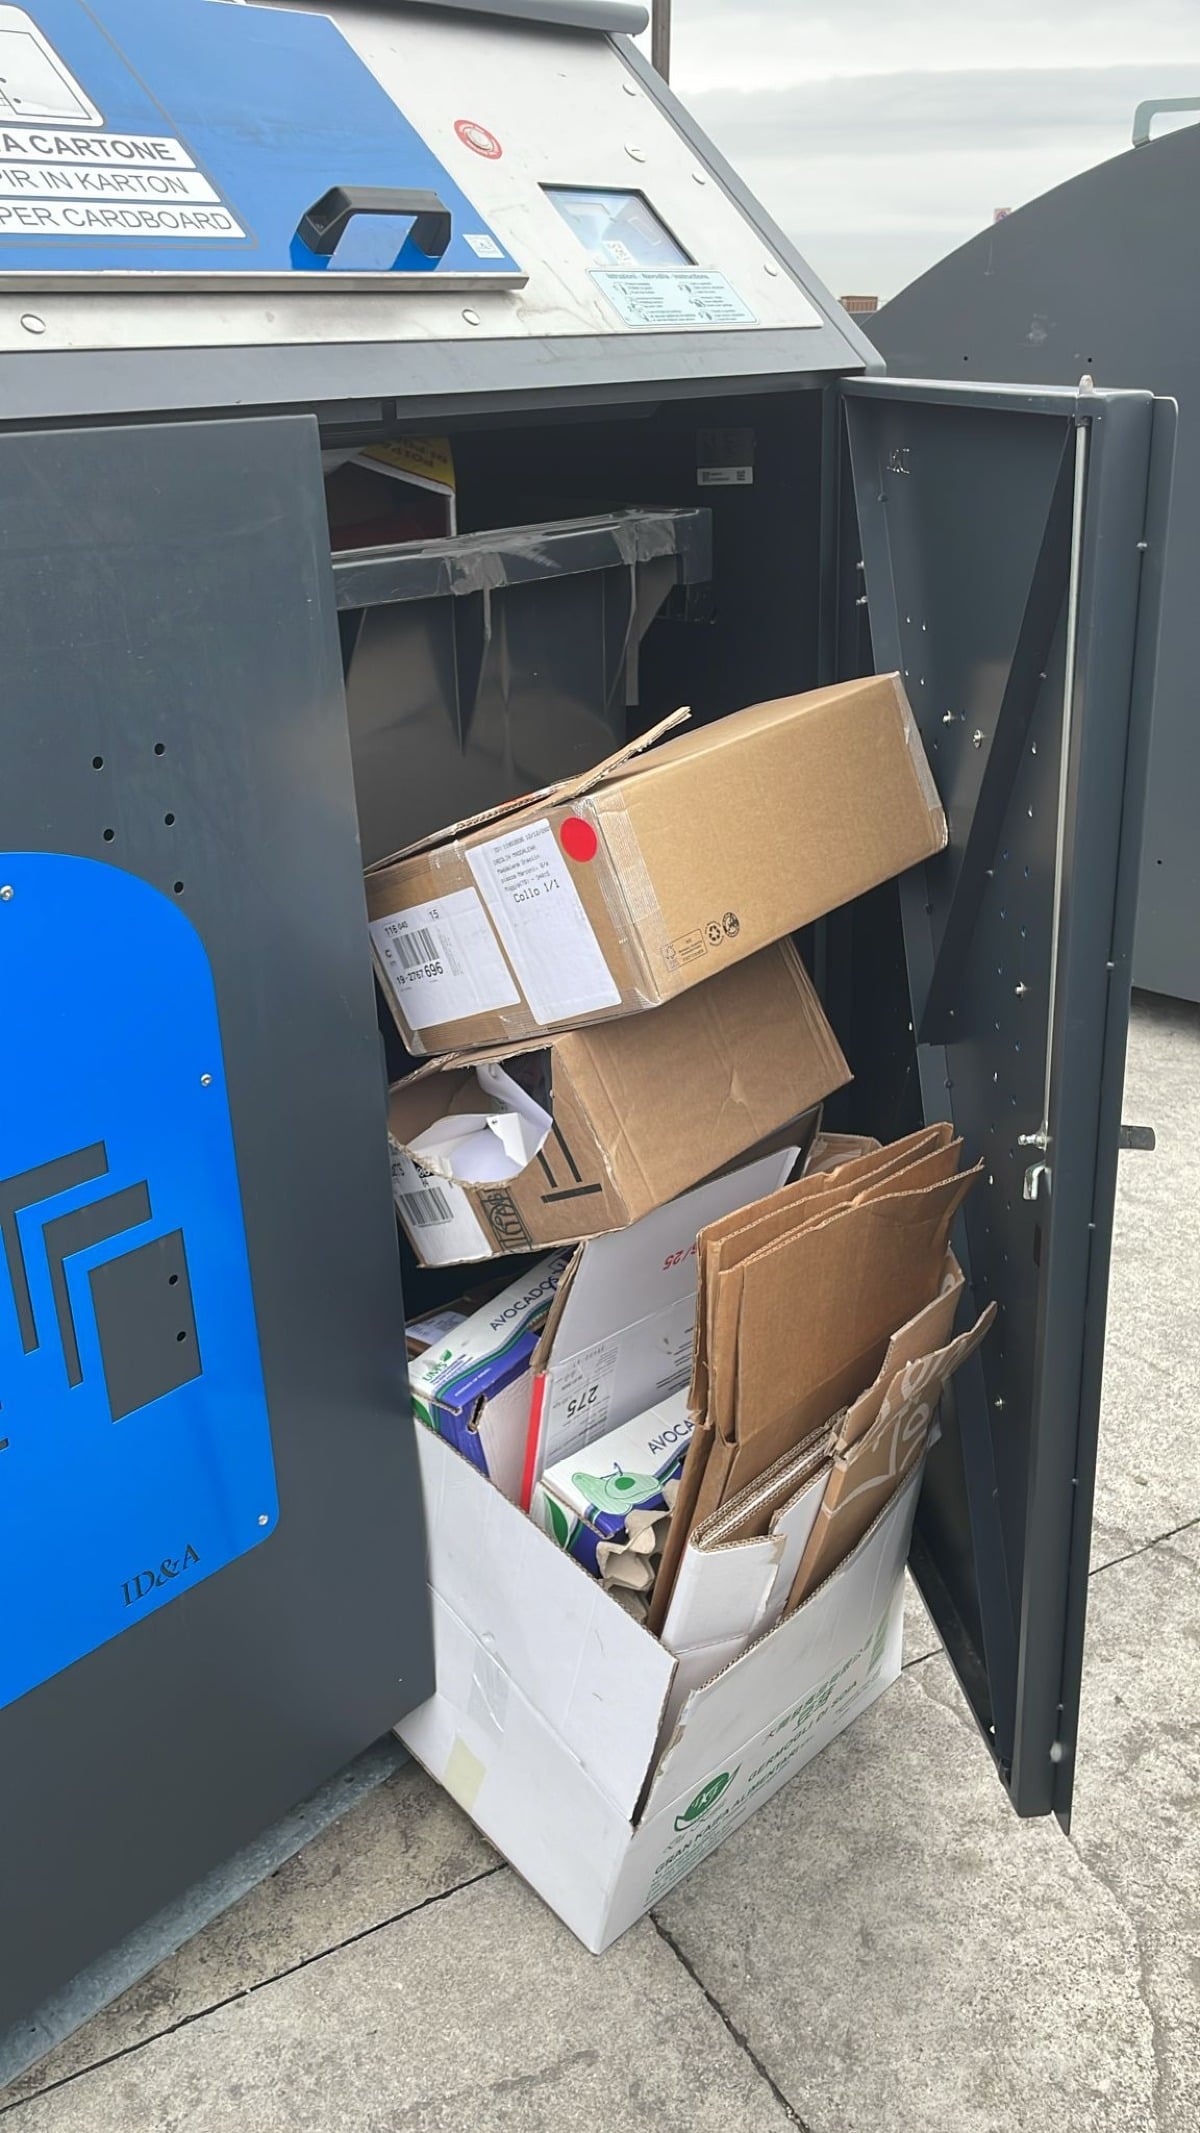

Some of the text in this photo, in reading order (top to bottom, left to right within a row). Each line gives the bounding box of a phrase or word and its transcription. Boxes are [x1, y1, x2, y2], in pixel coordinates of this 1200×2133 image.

[29, 135, 176, 161] CARTONE
[39, 171, 73, 190] IN
[75, 172, 190, 194] KARTON
[62, 208, 232, 230] CARDBOARD
[513, 888, 540, 903] Collo
[544, 879, 560, 892] 1/1
[567, 1385, 599, 1418] 275
[120, 1544, 200, 1607] ID&A
